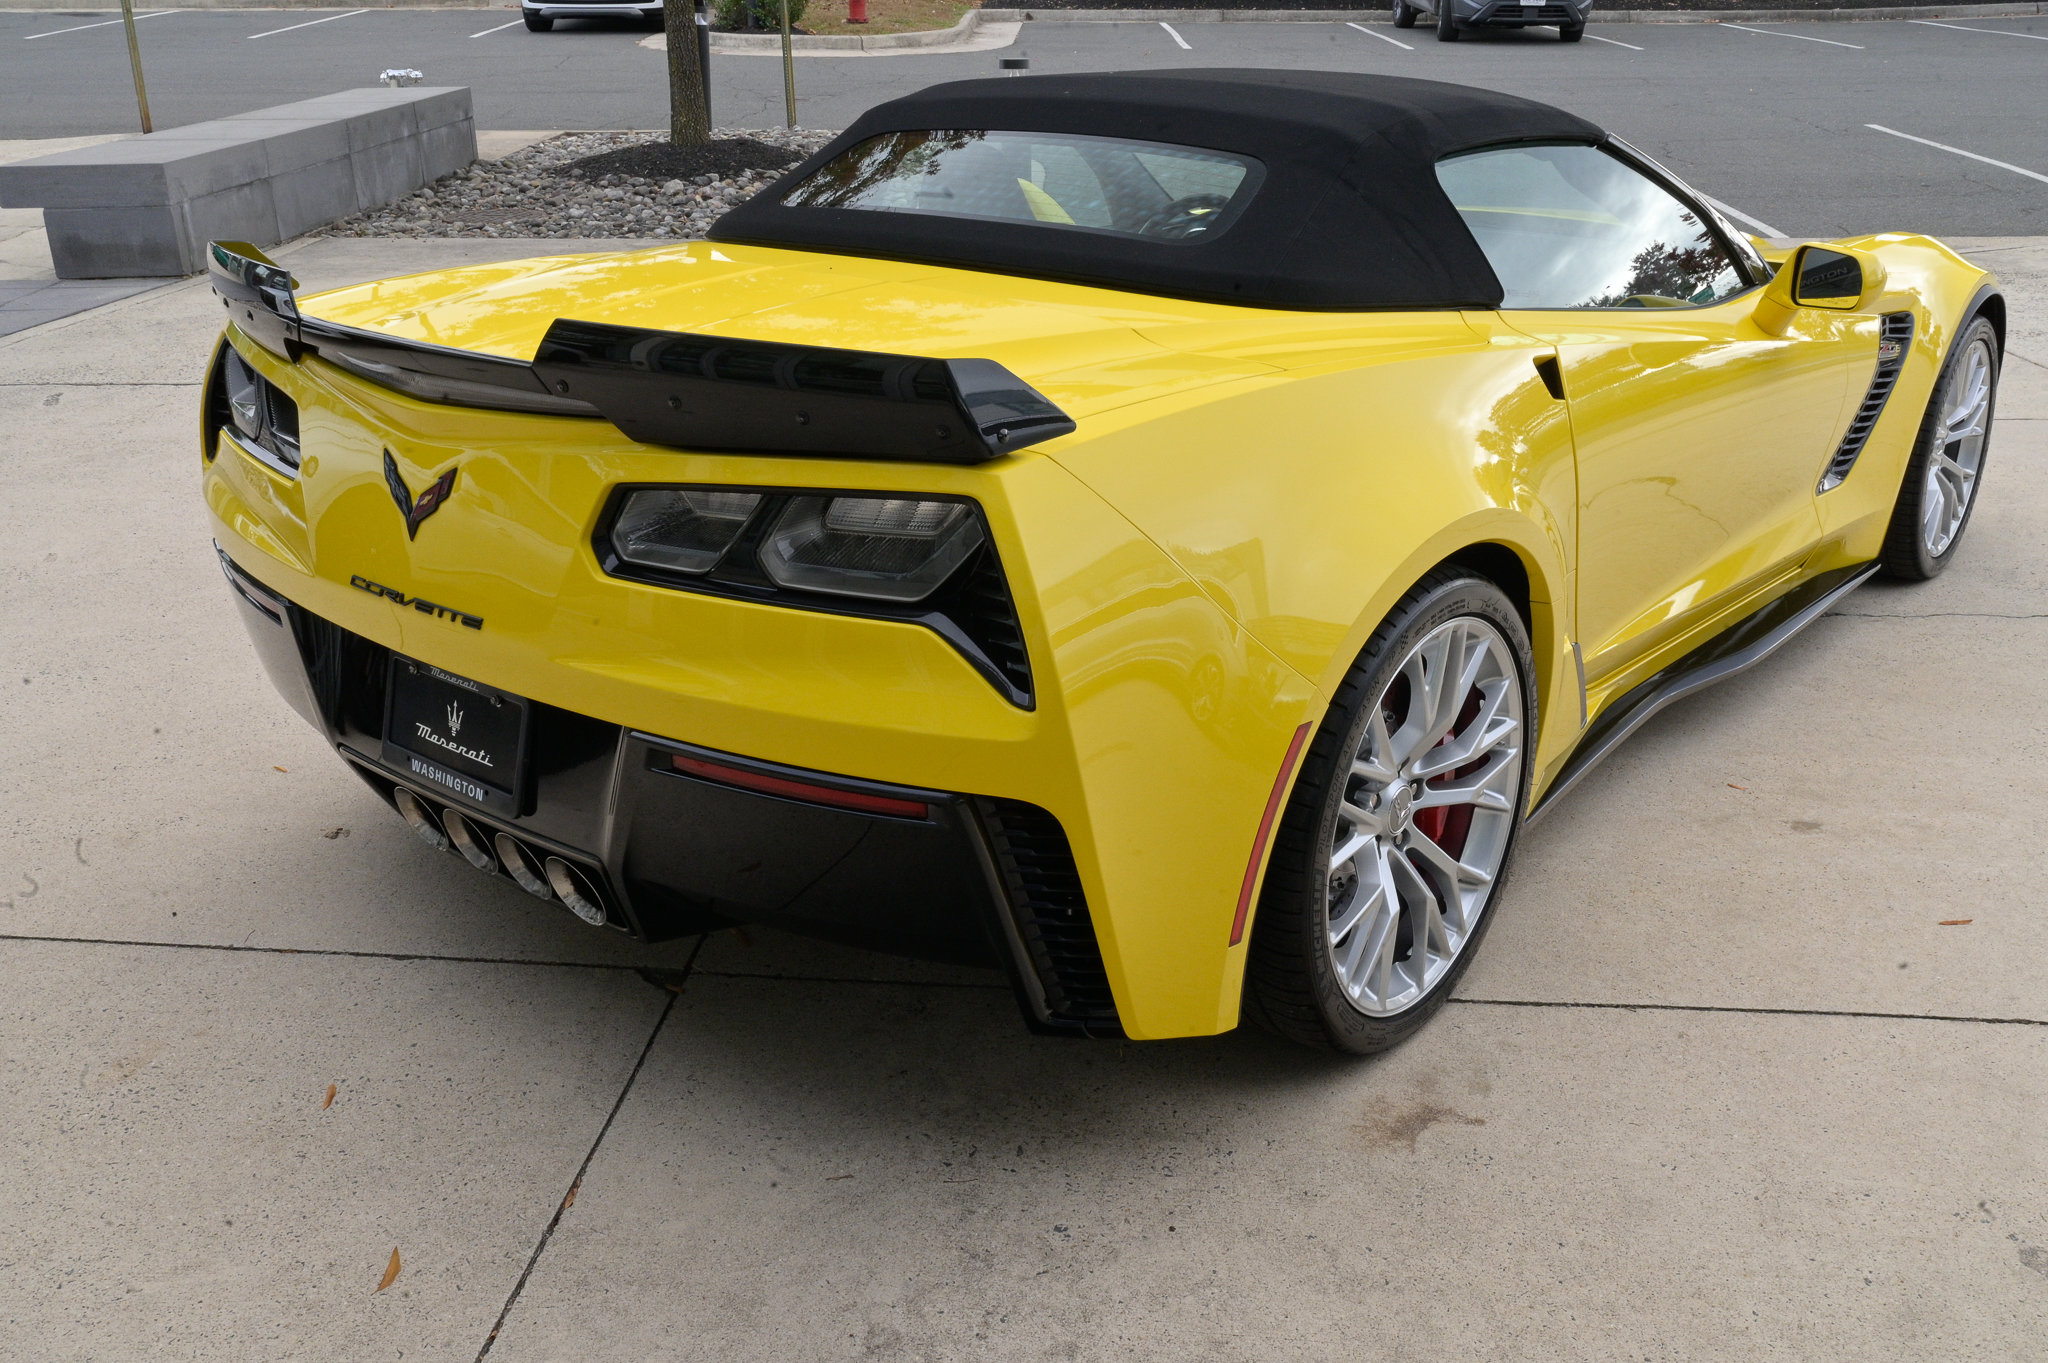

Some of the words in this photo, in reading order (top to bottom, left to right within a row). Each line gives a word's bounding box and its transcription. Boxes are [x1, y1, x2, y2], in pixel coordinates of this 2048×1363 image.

[350, 575, 484, 630] CORVETTE
[430, 666, 479, 692] Maserati
[415, 722, 494, 767] Maserati
[411, 758, 485, 802] WASHINGTON
